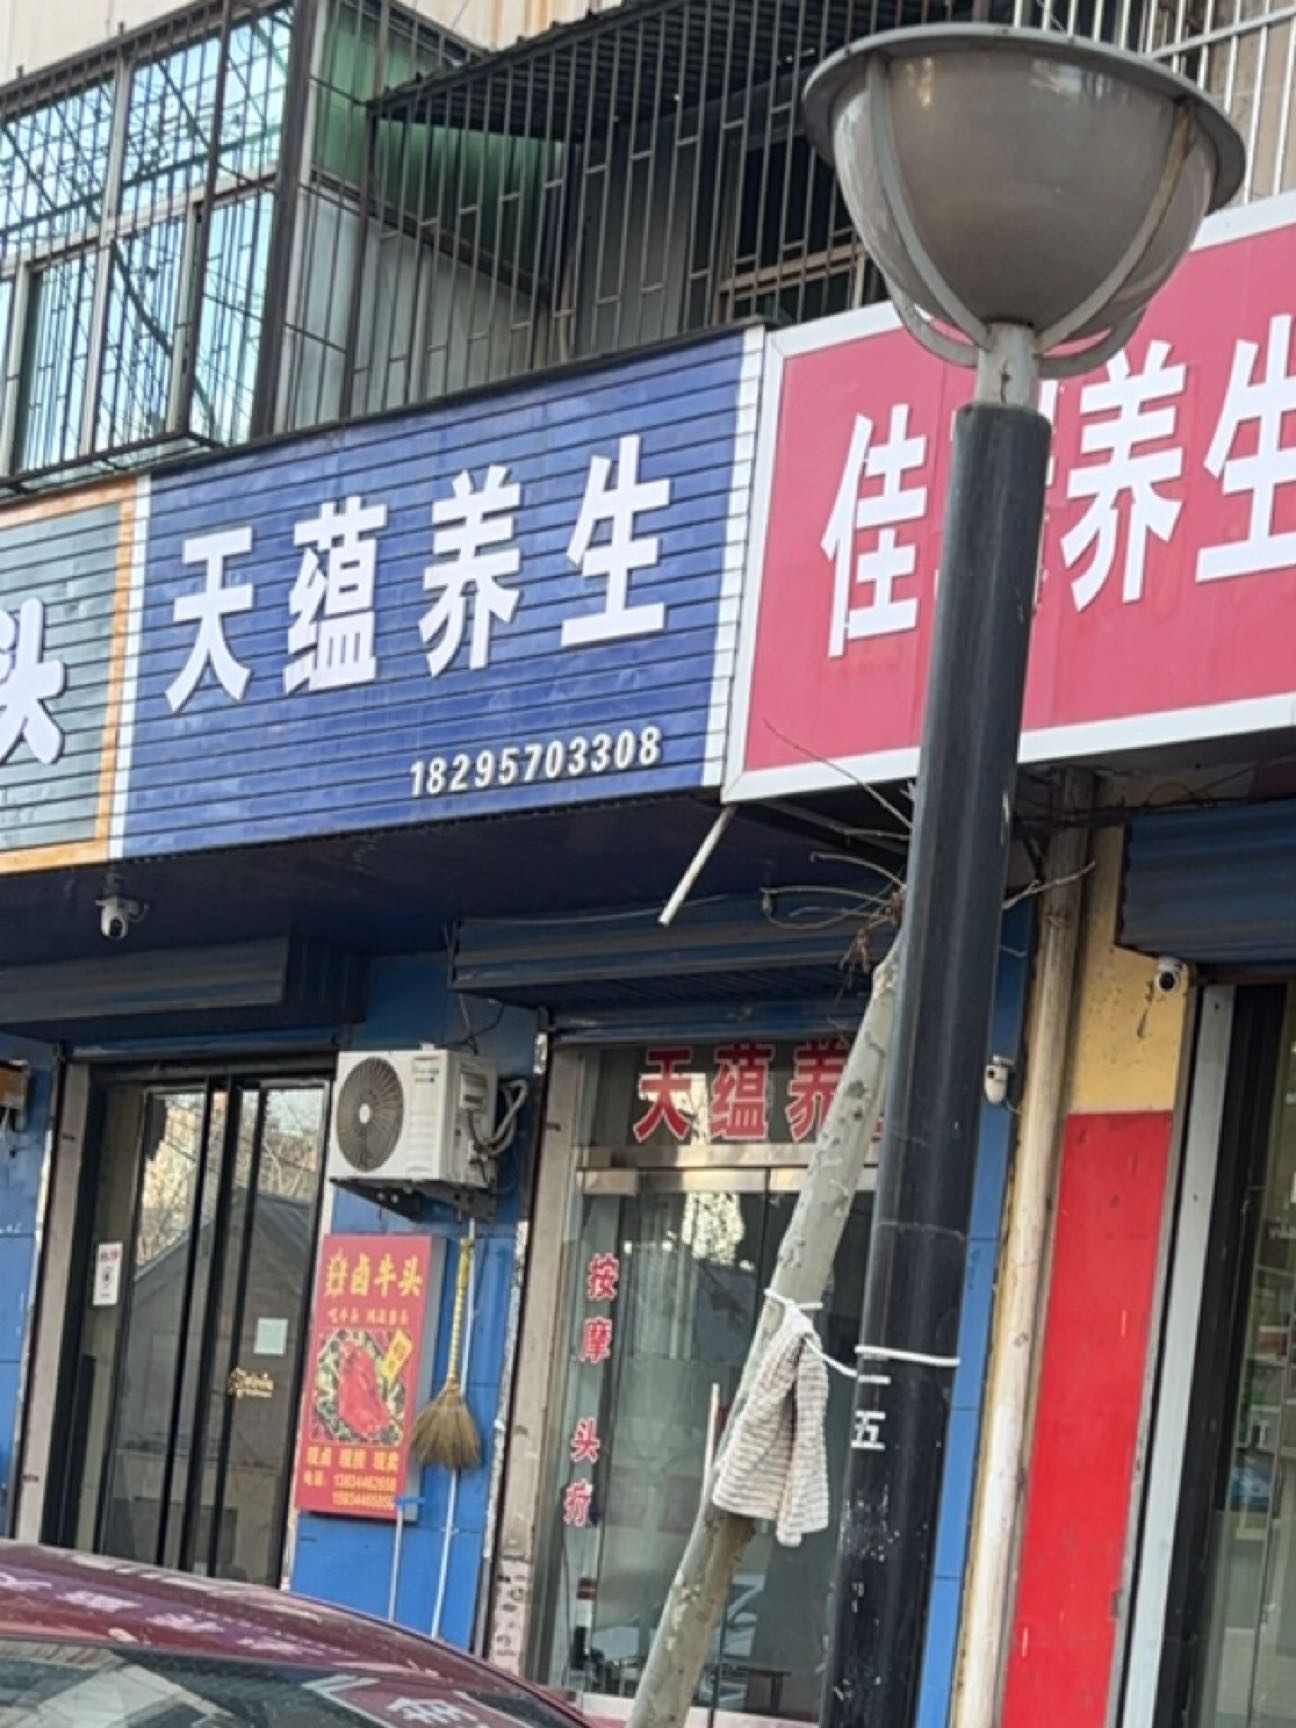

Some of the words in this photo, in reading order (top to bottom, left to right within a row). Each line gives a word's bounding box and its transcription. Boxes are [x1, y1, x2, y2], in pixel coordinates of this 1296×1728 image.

[164, 434, 672, 714] 天蕴养生
[409, 726, 662, 798] 18295703308
[633, 1040, 884, 1142] 天蕴养
[578, 1252, 620, 1365] 按摩
